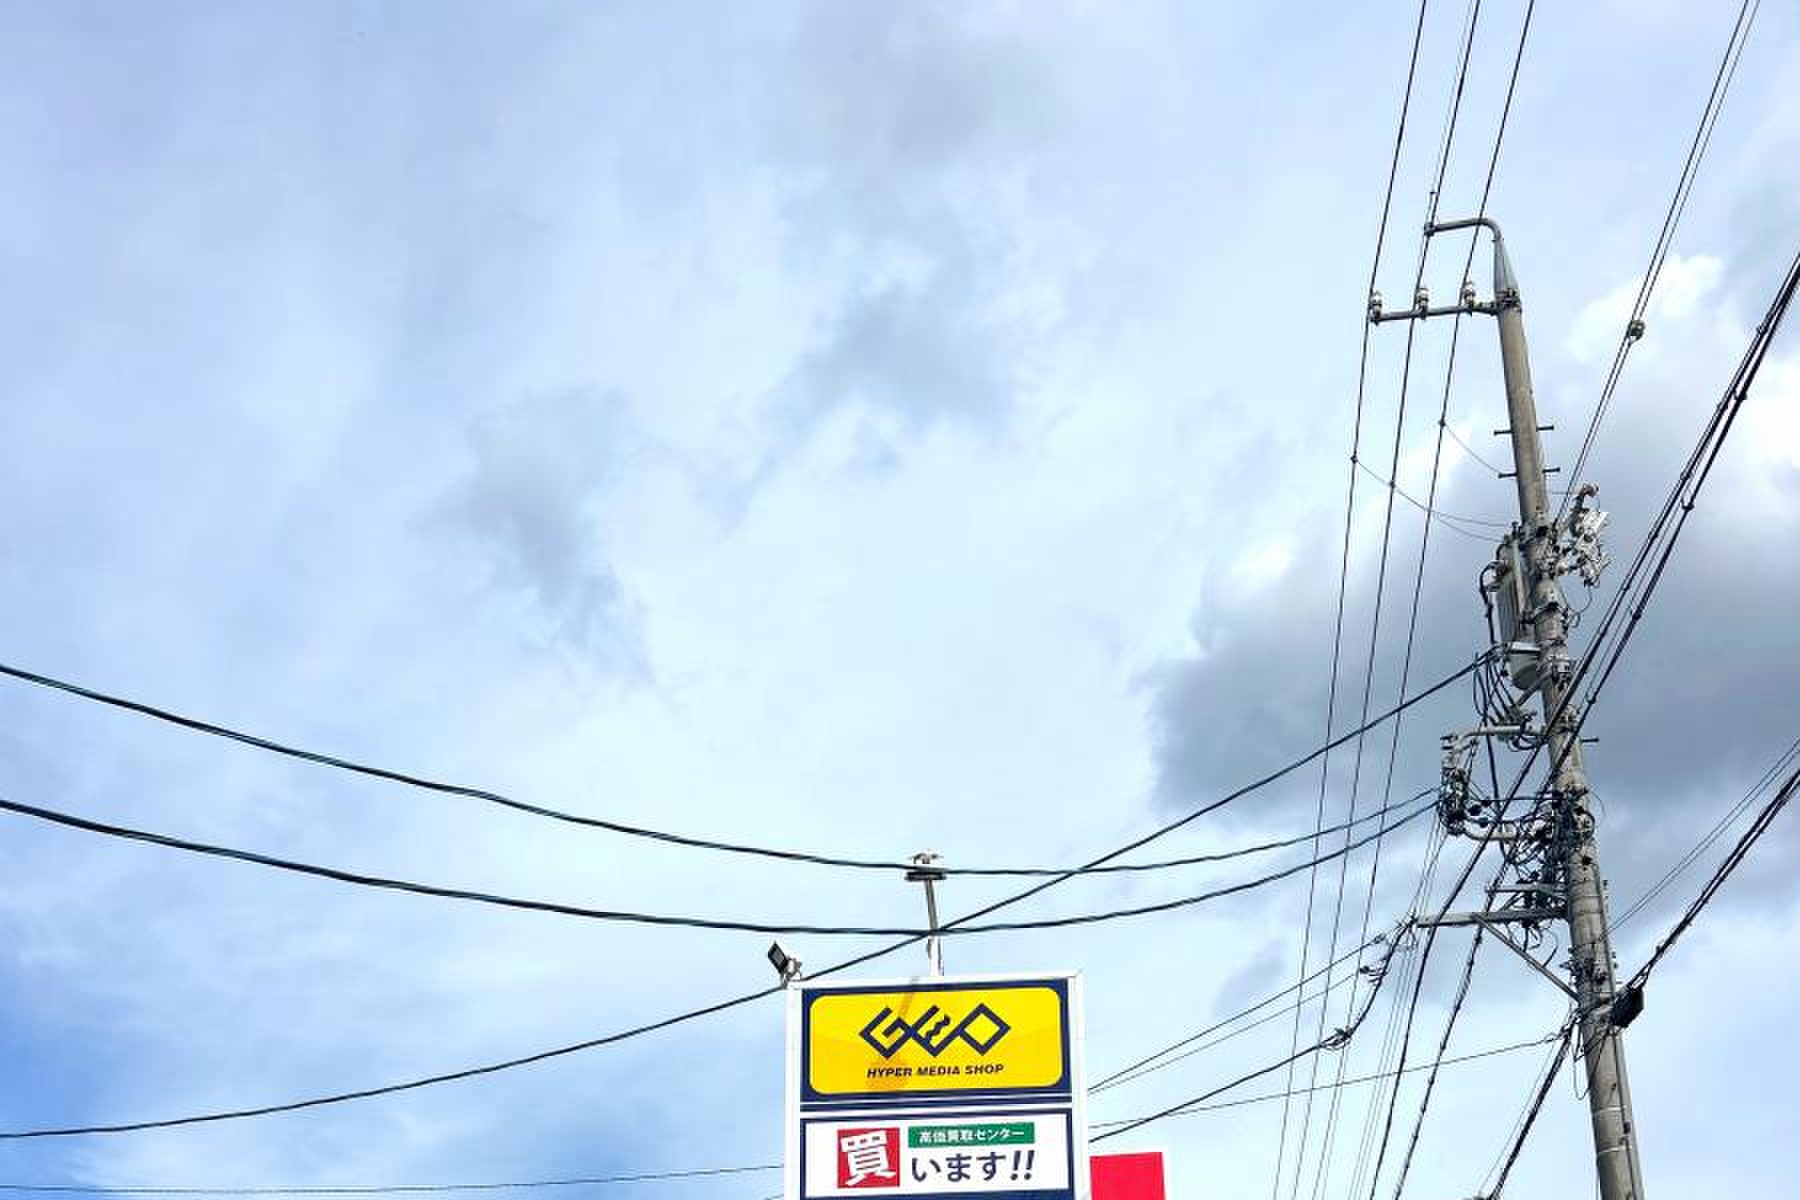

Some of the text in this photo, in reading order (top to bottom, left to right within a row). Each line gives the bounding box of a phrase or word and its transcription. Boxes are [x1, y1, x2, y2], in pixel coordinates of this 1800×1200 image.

[859, 1002, 1012, 1060] GEO
[866, 1063, 1004, 1079] HYPER MEDIA SHOP
[918, 1127, 1026, 1144] 高価買取センター
[840, 1132, 898, 1187] 買
